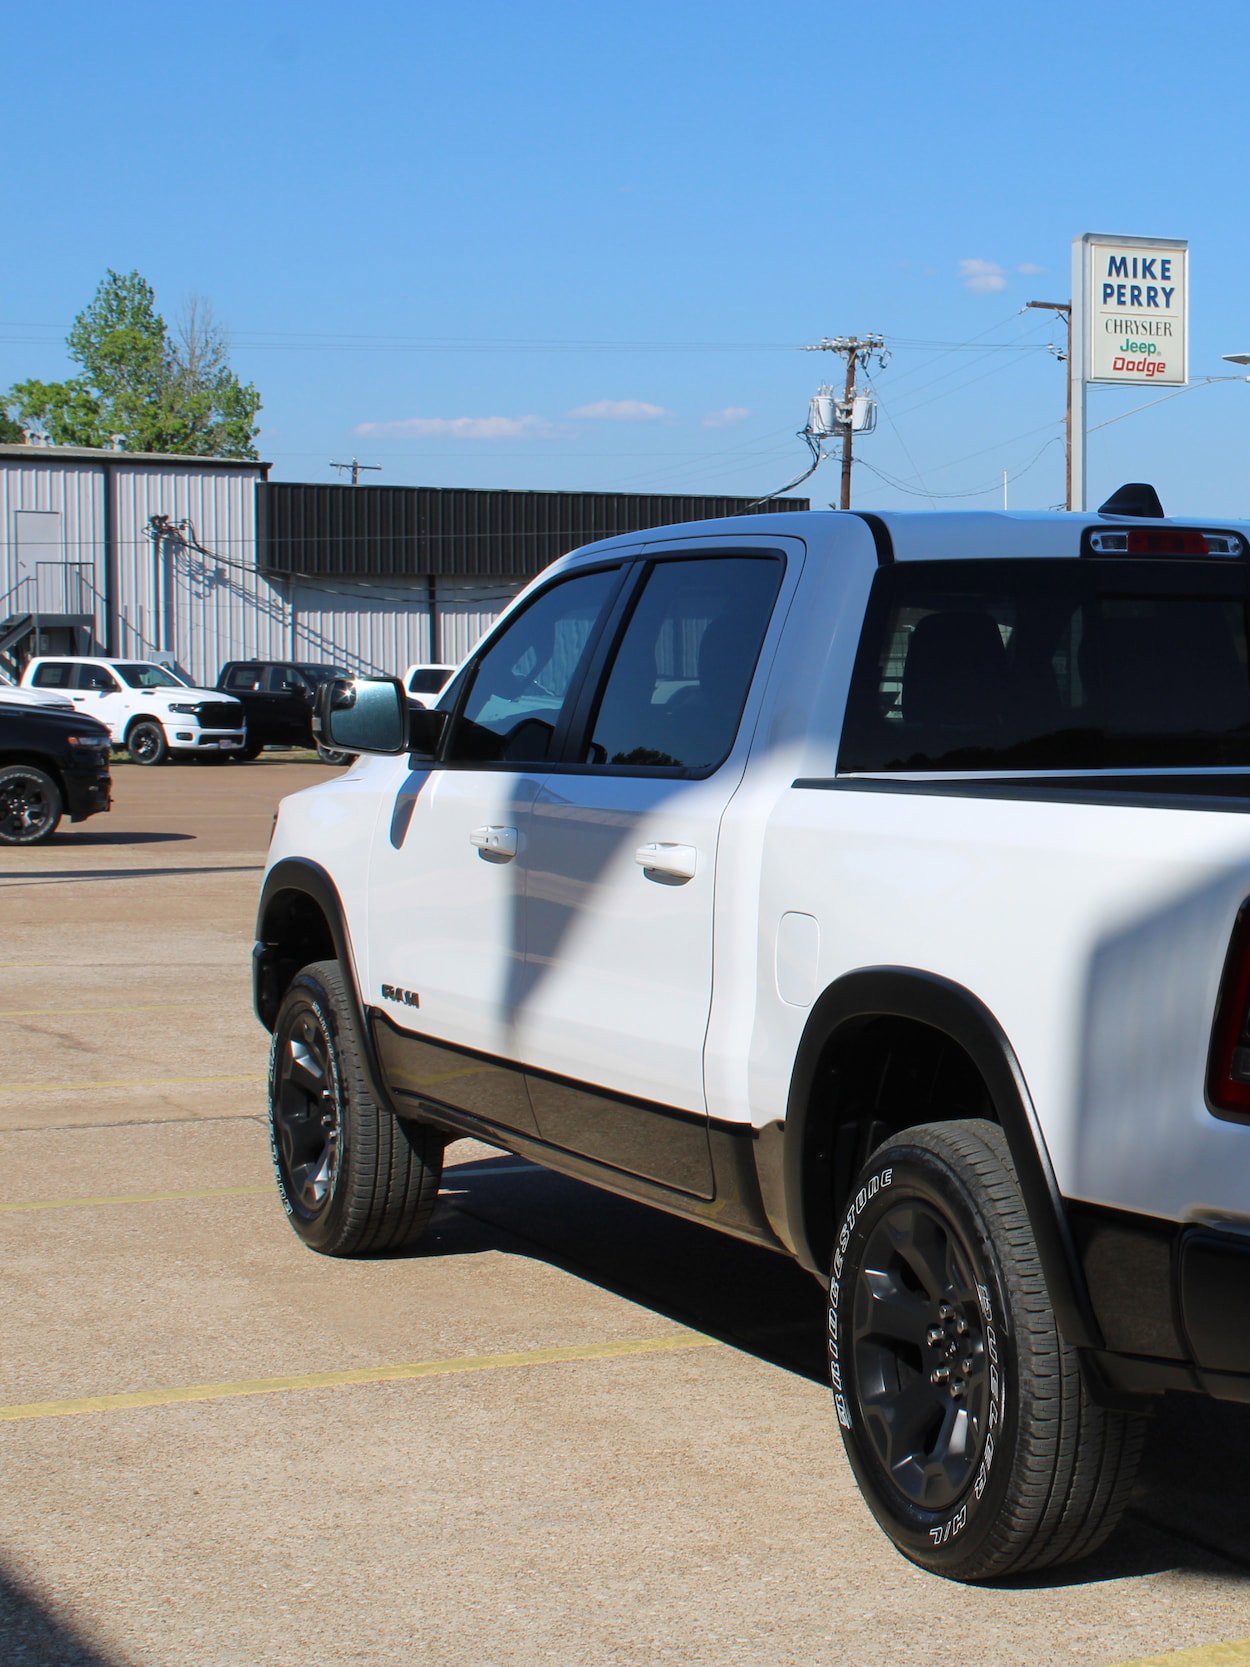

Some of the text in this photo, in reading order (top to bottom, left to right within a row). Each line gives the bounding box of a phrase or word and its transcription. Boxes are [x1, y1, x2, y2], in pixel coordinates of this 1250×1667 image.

[1108, 256, 1171, 281] MIKE
[1103, 283, 1175, 308] PERRY
[1105, 319, 1173, 337] CHRYSLER
[1120, 338, 1157, 357] Jeep
[1113, 357, 1166, 377] Dodge
[382, 983, 421, 1009] RAM
[828, 1168, 893, 1430] BRIDGESTONE
